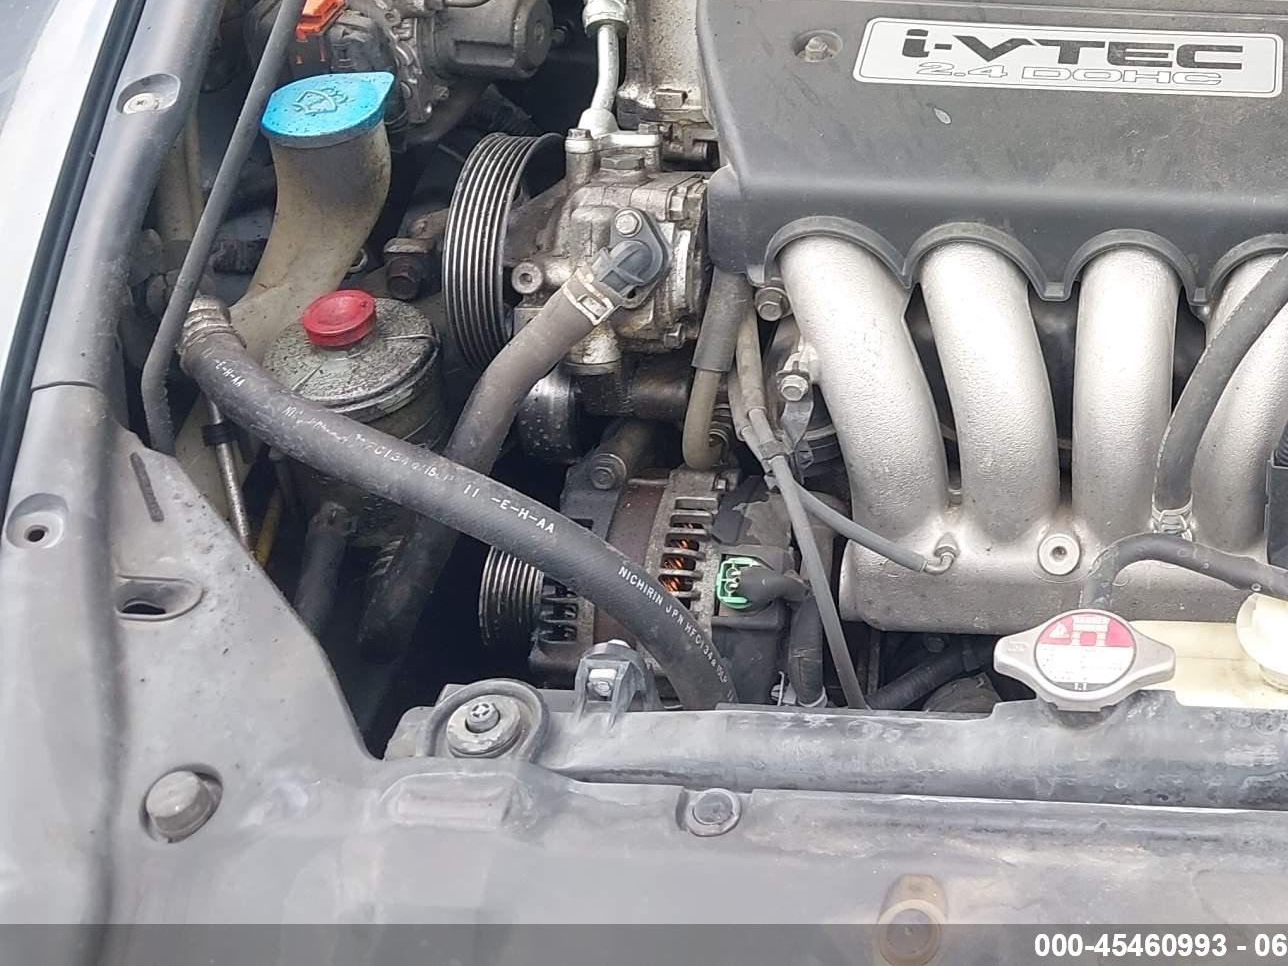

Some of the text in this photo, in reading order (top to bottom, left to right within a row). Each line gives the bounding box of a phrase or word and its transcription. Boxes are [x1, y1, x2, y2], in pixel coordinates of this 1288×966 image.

[901, 28, 1244, 70] i-VTEC
[915, 61, 1223, 86] 2.4 DOHC
[618, 565, 664, 606] NICHIRIN
